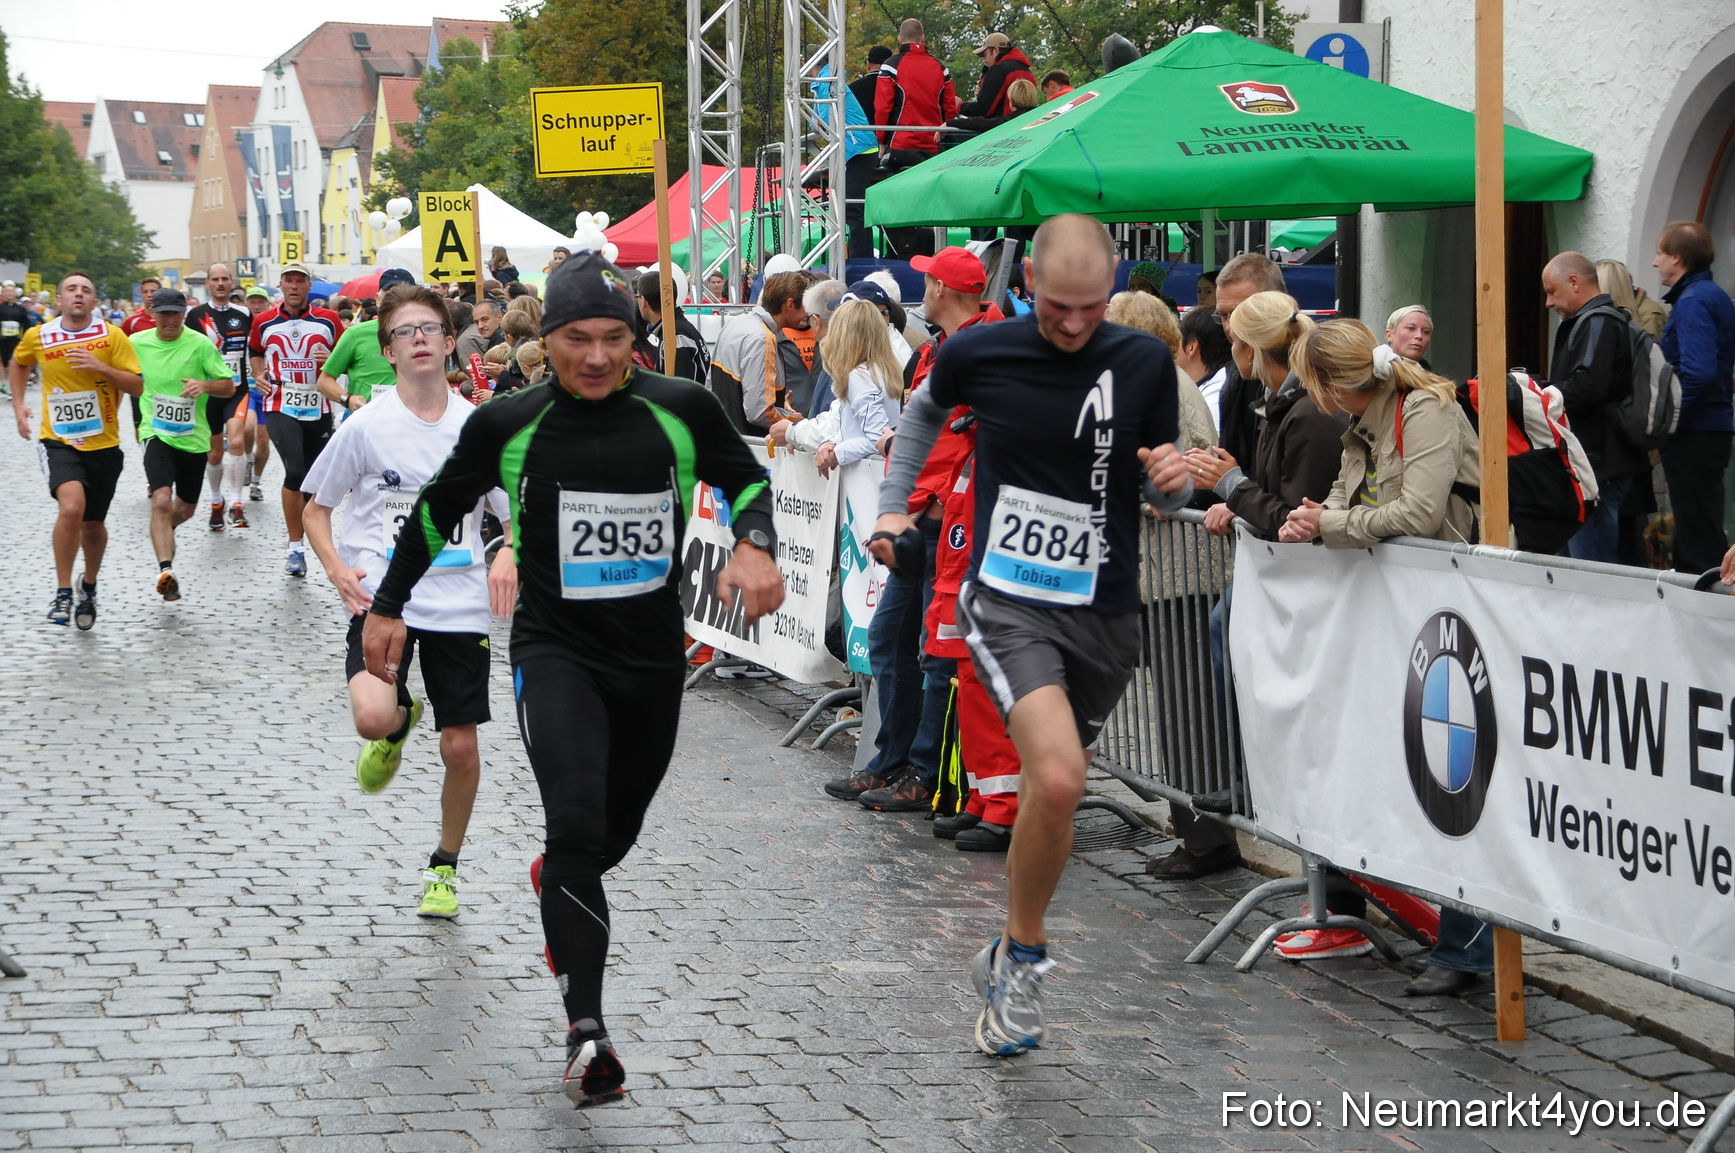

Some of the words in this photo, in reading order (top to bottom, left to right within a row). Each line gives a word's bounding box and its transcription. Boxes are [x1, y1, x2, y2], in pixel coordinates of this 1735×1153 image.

[1256, 106, 1285, 114] 1628
[541, 112, 653, 131] Schnupper-
[1199, 121, 1366, 139] Neumarkter
[580, 134, 616, 153] lauf
[1175, 135, 1412, 157] Lammsbräu
[426, 195, 473, 212] Block
[282, 232, 302, 241] Block
[435, 219, 470, 263] A
[285, 242, 299, 261] B
[281, 361, 314, 370] BIMBO
[285, 391, 319, 407] 2513
[54, 401, 96, 422] 2962
[156, 403, 191, 422] 2905
[562, 502, 602, 514] PARTL
[604, 503, 658, 515] Neumarkt
[999, 494, 1032, 513] PARTL
[1034, 503, 1087, 525] Neumarkt
[571, 518, 664, 557] 2953
[998, 512, 1091, 567] 2684
[789, 537, 814, 567] Herzen
[600, 566, 638, 582] klaus
[1013, 564, 1062, 588] Tobias
[774, 611, 796, 640] 92318
[1521, 655, 1669, 778] BMW
[1525, 776, 1677, 882] Weniger
